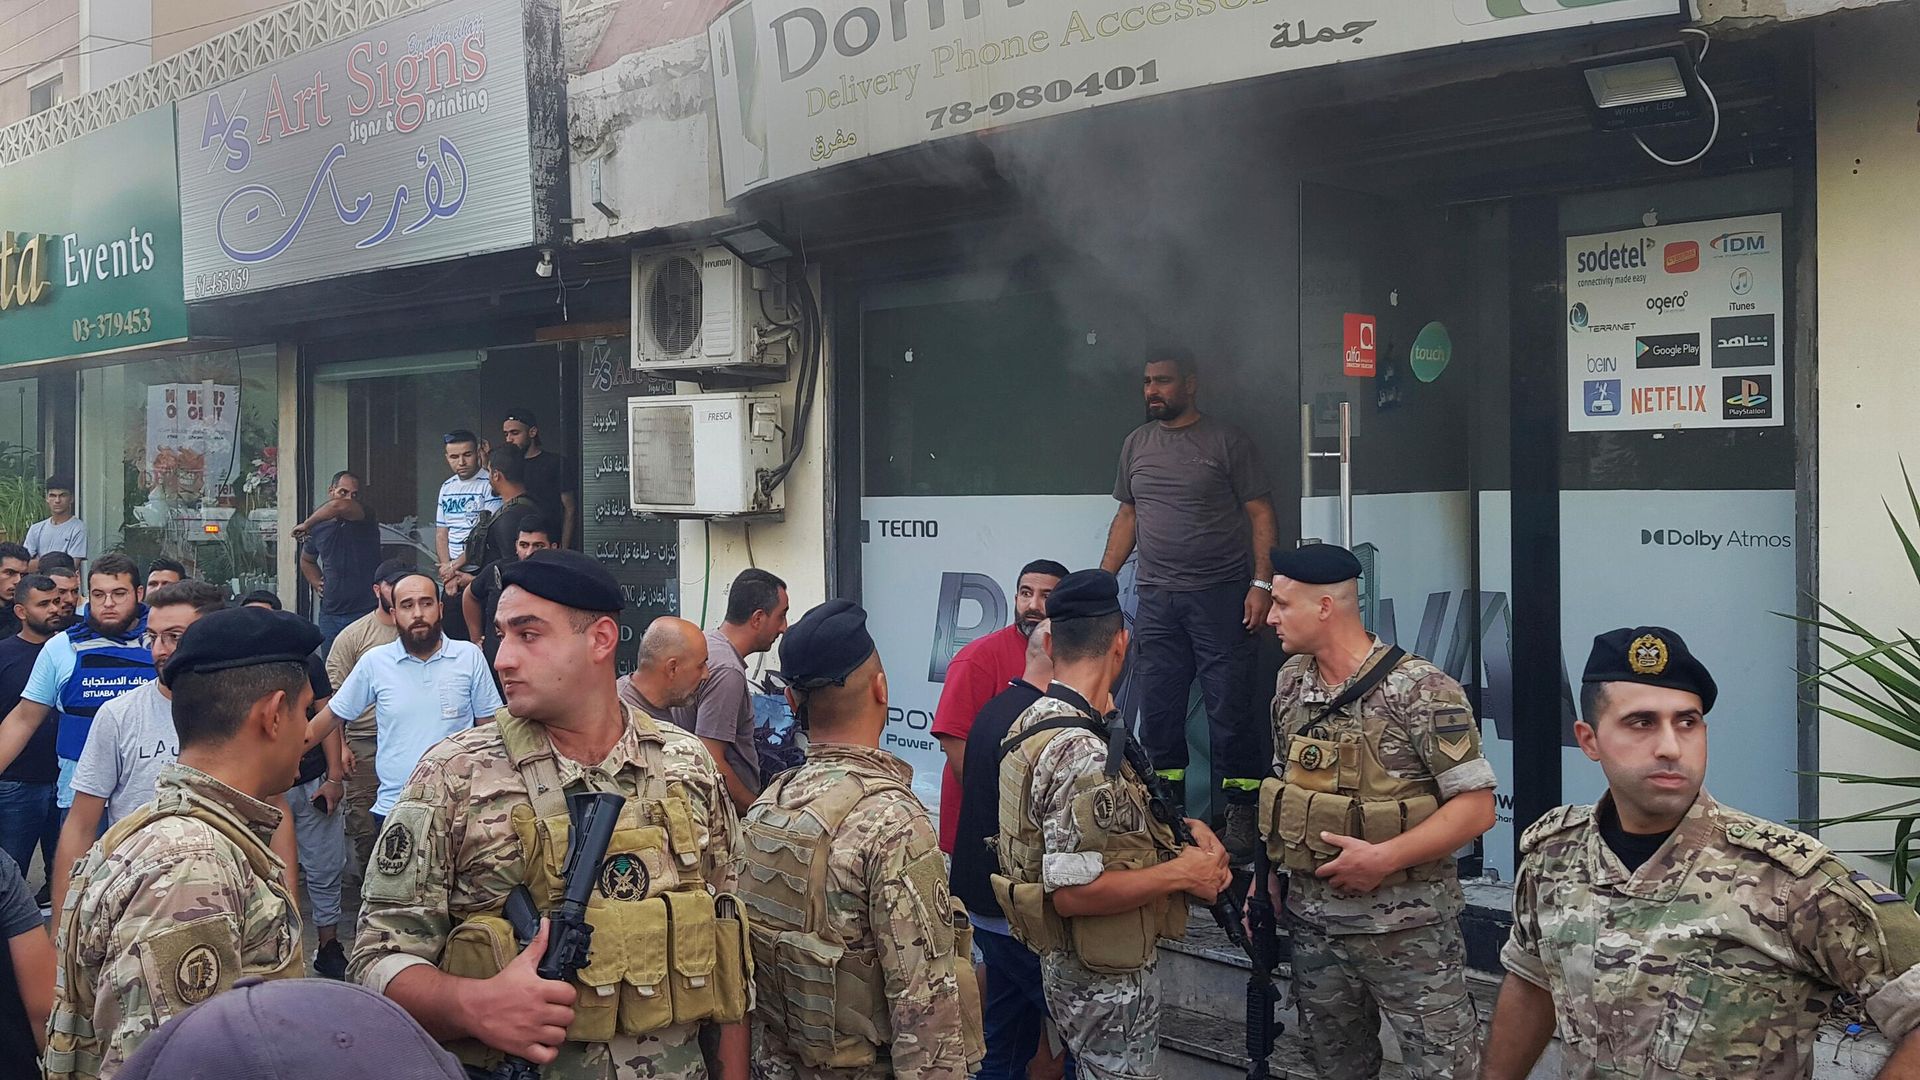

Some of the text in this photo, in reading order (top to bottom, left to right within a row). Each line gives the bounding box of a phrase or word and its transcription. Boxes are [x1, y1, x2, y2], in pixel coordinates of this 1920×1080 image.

[1269, 18, 1378, 50] جملة
[806, 63, 921, 118] Delivery
[931, 30, 1050, 79] Phone
[257, 37, 488, 144] Art Signs
[924, 59, 1159, 132] 78-980401
[349, 118, 382, 145] Signs
[426, 87, 489, 122] Printing
[809, 128, 857, 162] مفرق
[62, 226, 155, 288] Events
[704, 258, 732, 269] HYUNDAI
[1577, 237, 1647, 274] sodetel
[194, 266, 250, 297] 81-455059
[1577, 274, 1647, 288] connectivity made easy
[1646, 295, 1685, 315] ogero
[1728, 302, 1756, 312] iTunes
[71, 307, 152, 342] 03-379453
[1588, 322, 1637, 333] TERRANET
[1652, 343, 1700, 357] Google Play
[1717, 334, 1768, 348] شاهد
[1346, 346, 1361, 363] alfa
[1415, 345, 1445, 361] touch
[1631, 385, 1707, 415] NETFLIX
[707, 411, 733, 421] FRESCA
[878, 520, 938, 538] TECNO
[1668, 529, 1792, 550] Dolby Atmos
[632, 542, 650, 566] طباعة
[83, 690, 115, 698] ISTIJABA
[886, 733, 935, 751] Power
